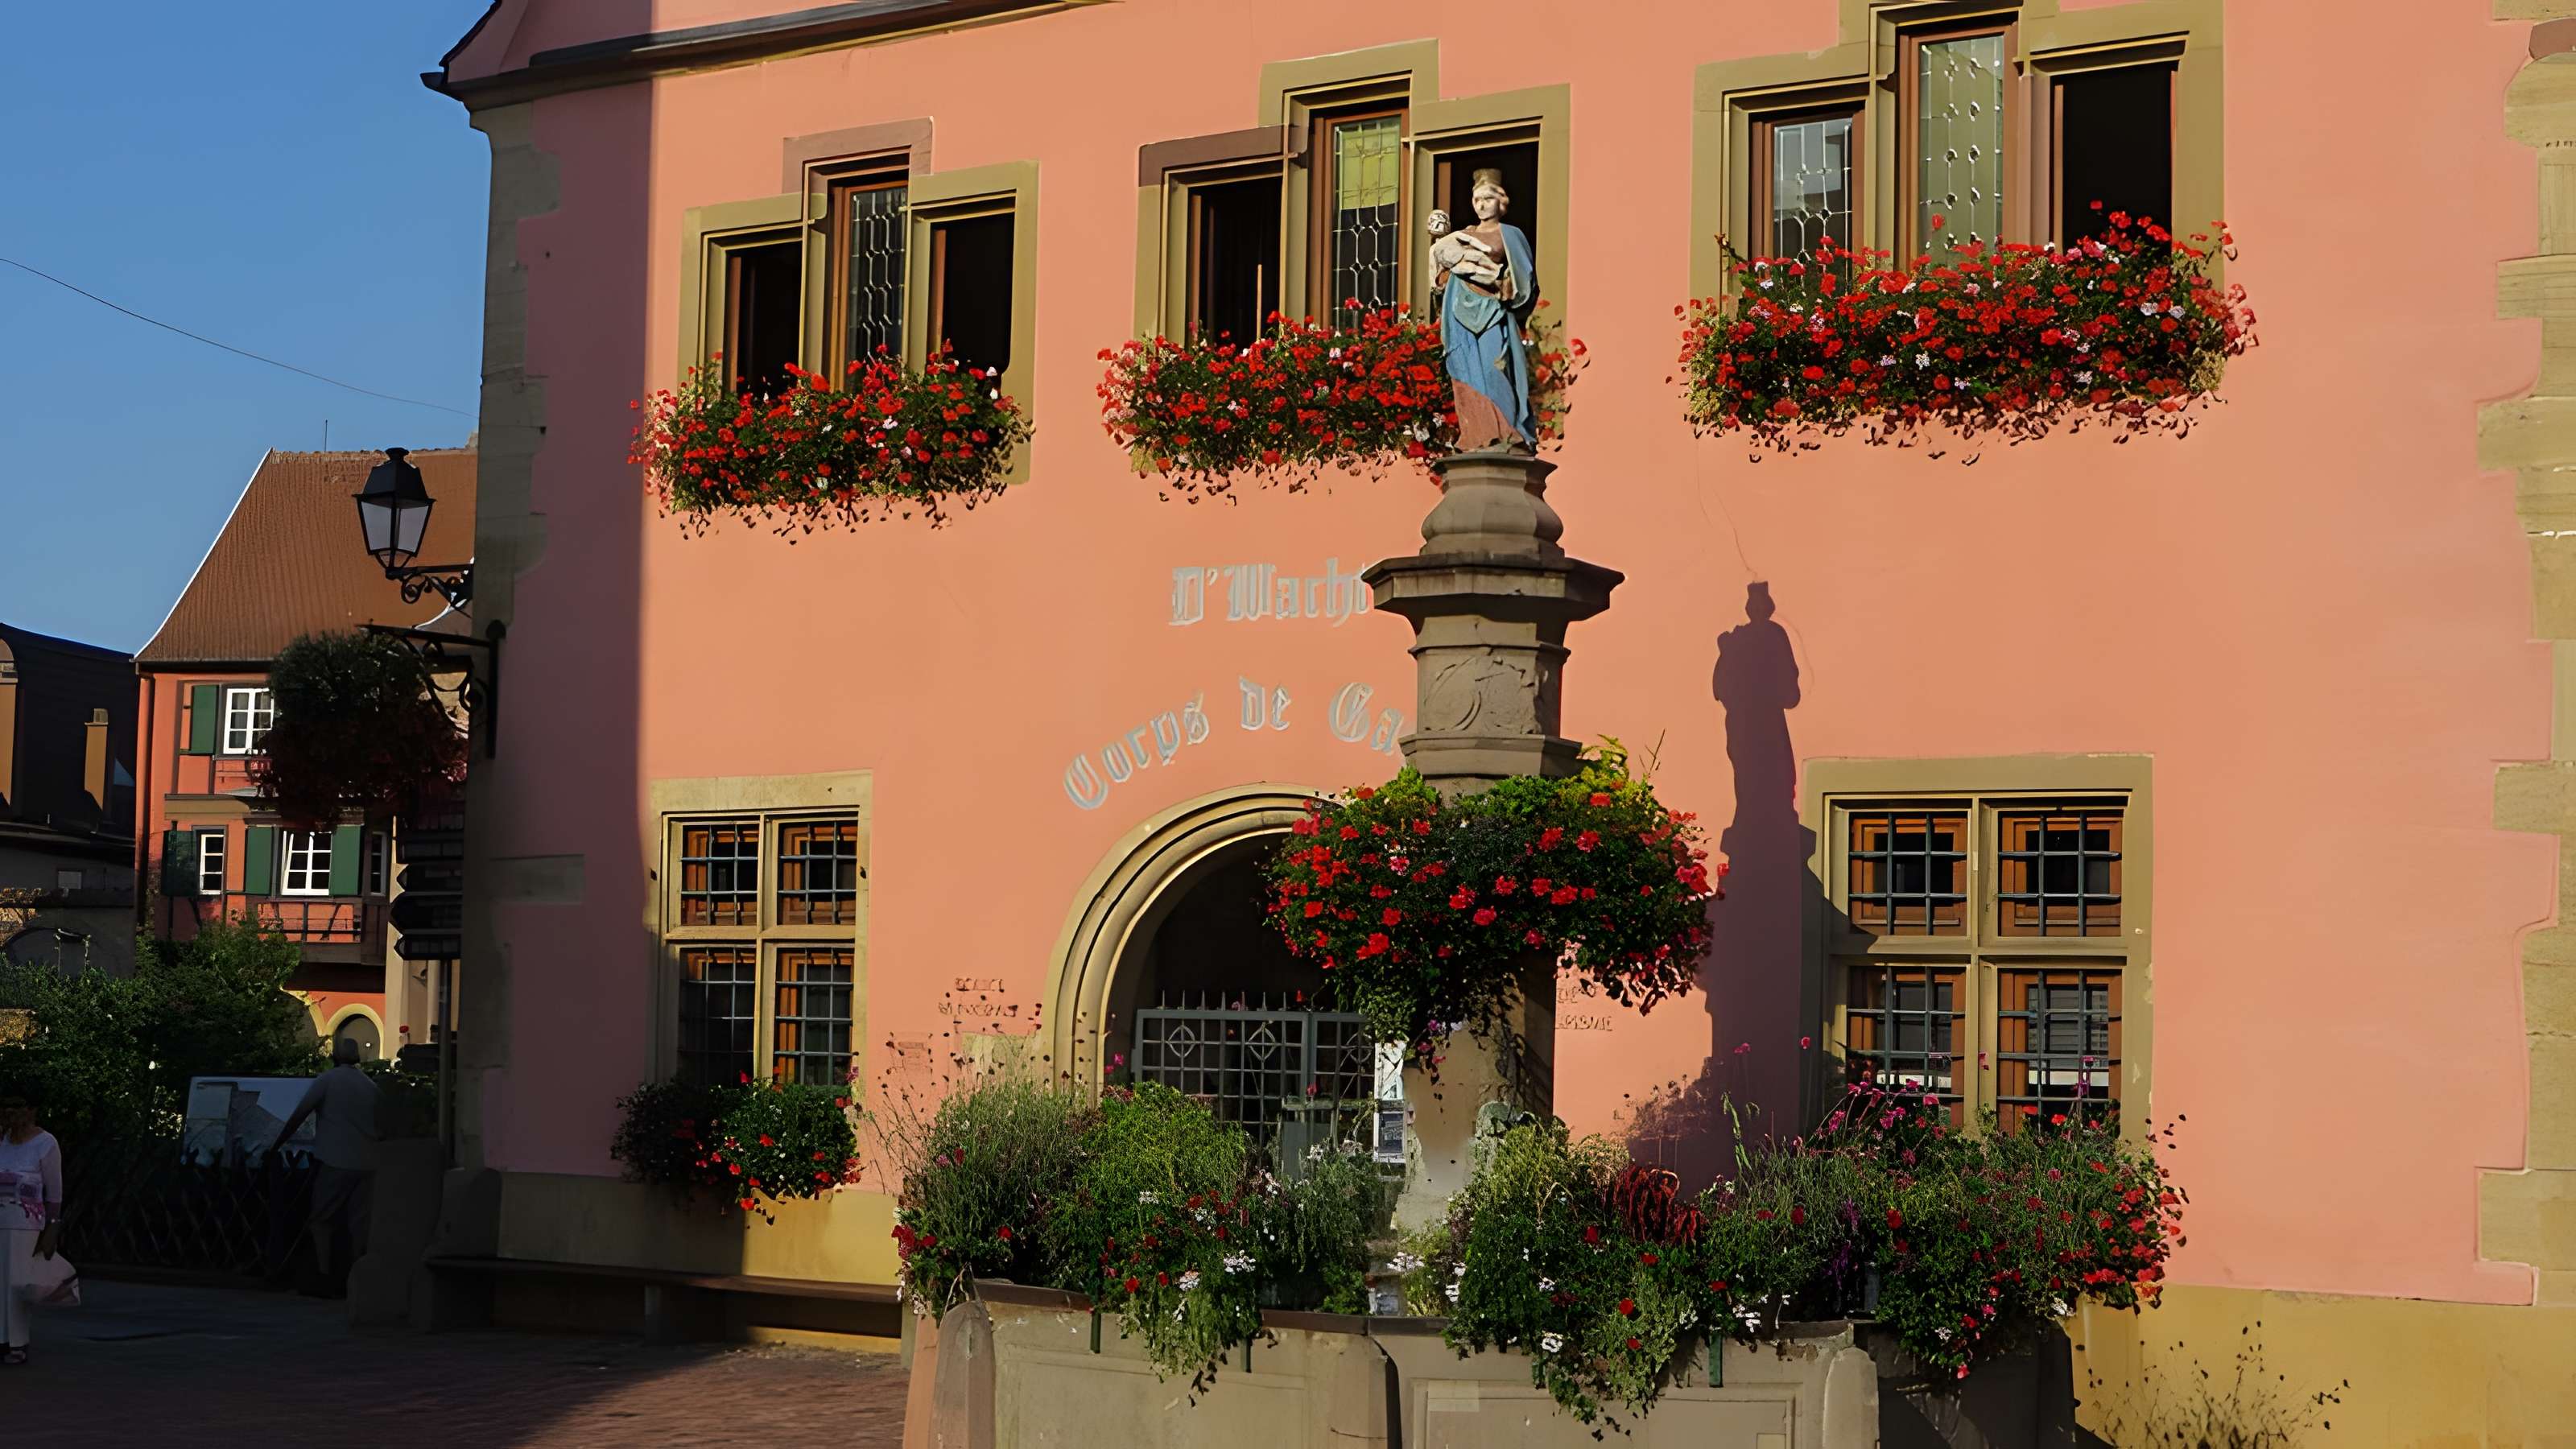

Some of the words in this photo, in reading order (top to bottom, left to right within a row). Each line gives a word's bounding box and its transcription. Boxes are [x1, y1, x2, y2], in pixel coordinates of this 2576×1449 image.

[1063, 691, 1210, 810] Corps
[1238, 675, 1291, 731] de
[1328, 682, 1404, 756] Ga
